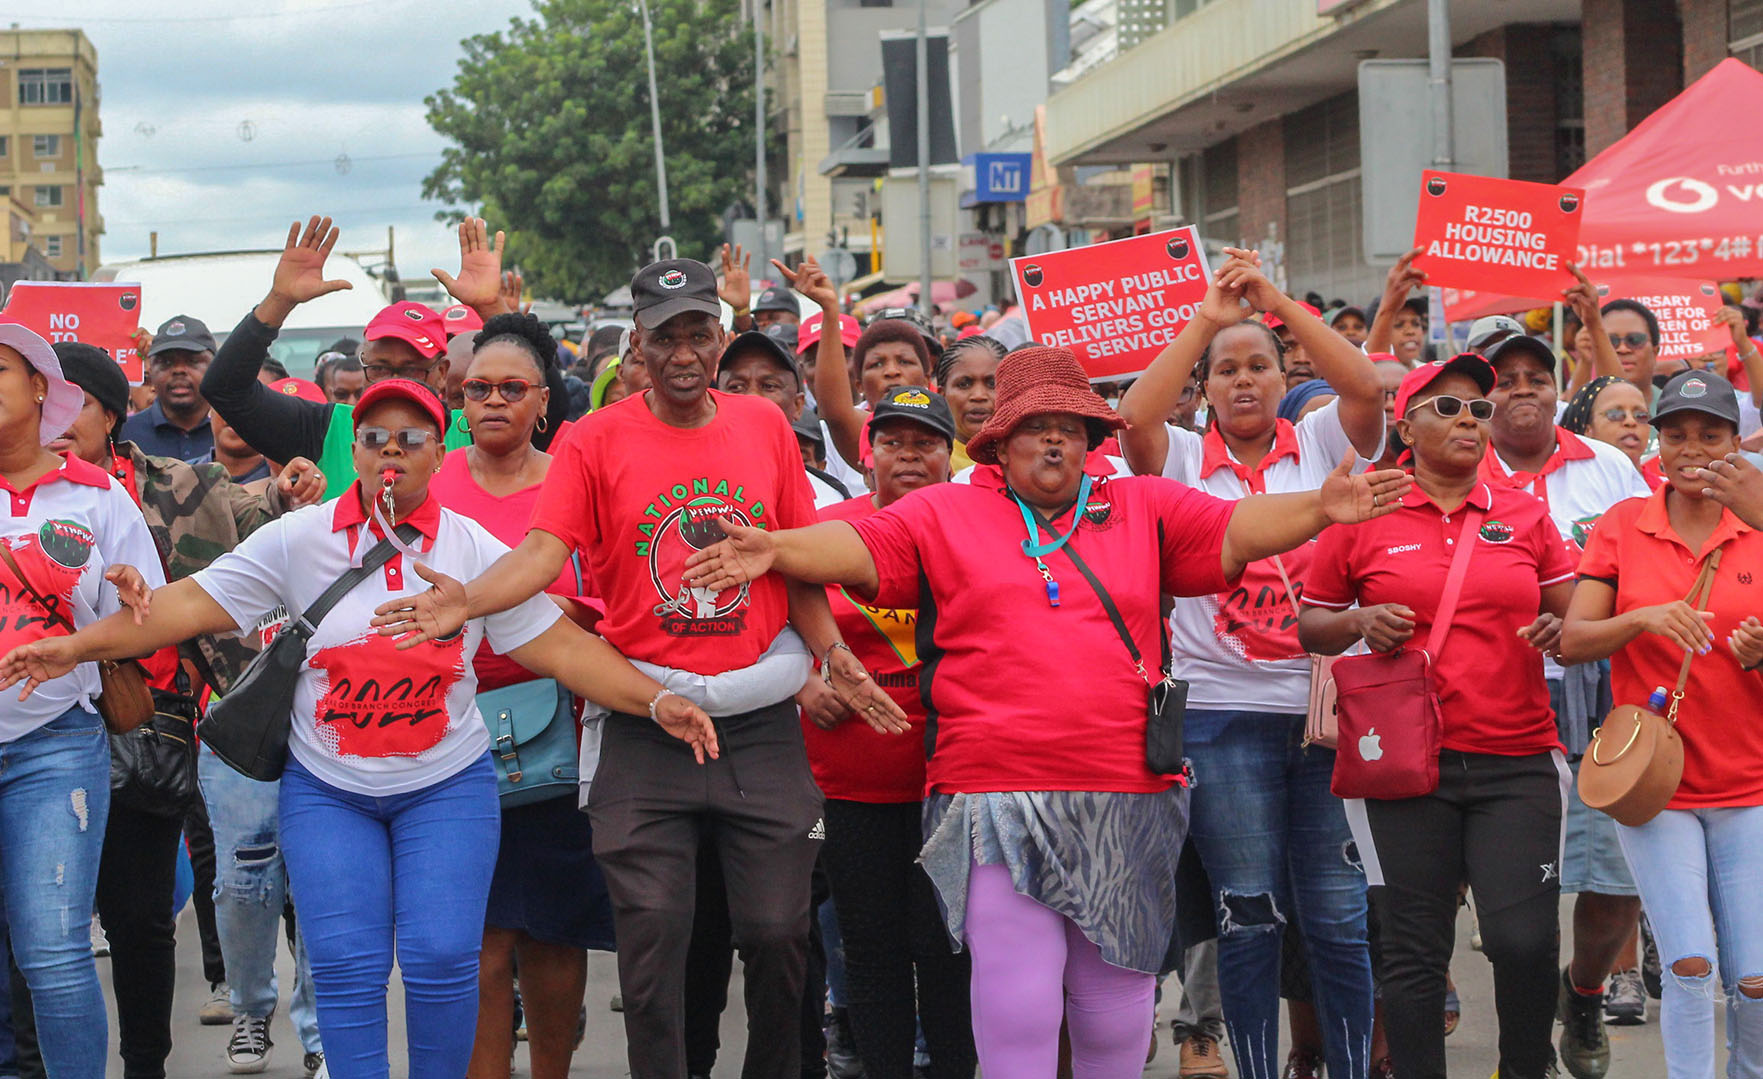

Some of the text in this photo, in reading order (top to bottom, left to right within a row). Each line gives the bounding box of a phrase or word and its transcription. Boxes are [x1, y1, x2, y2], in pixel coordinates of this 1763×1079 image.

[1465, 205, 1532, 229] R2500
[1446, 223, 1546, 250] HOUSING
[1427, 240, 1559, 270] ALLOWANCE
[1032, 263, 1200, 311] A HAPPY PUBLIC
[1071, 290, 1165, 325] SERVANT
[1676, 307, 1706, 319] FOR
[49, 313, 80, 329] NO
[1041, 315, 1144, 349] DELIVERS
[1691, 319, 1711, 331] OF
[50, 332, 79, 343] TO
[1086, 328, 1176, 359] SERVICE
[635, 477, 746, 557] NATIONAL
[1387, 543, 1422, 555] SBOSHY
[671, 620, 736, 633] OF ACTION
[351, 702, 389, 710] BRANCH
